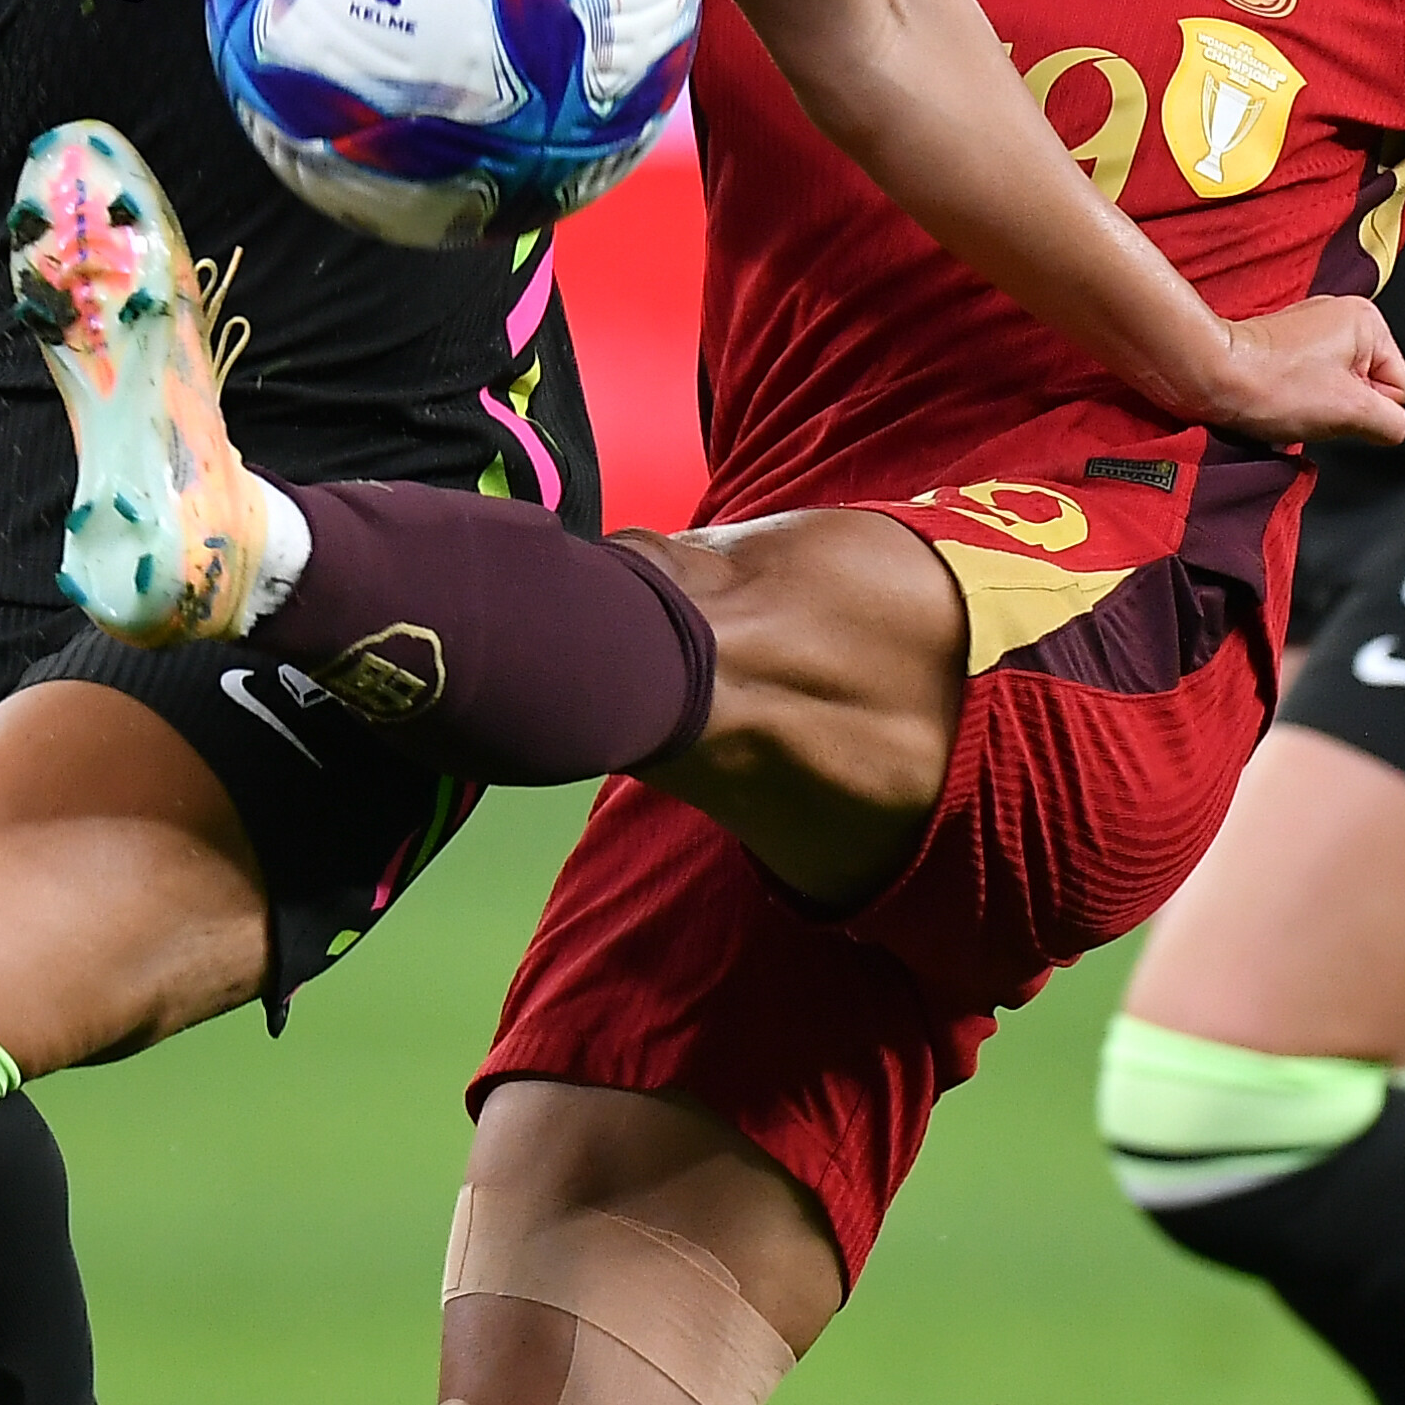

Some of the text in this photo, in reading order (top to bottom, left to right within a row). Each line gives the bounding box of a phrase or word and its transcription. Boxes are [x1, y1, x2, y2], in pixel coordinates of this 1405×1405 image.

[349, 1, 417, 35] KELME
[1203, 46, 1278, 92] CHAMPIONS
[1001, 42, 1148, 204] 9
